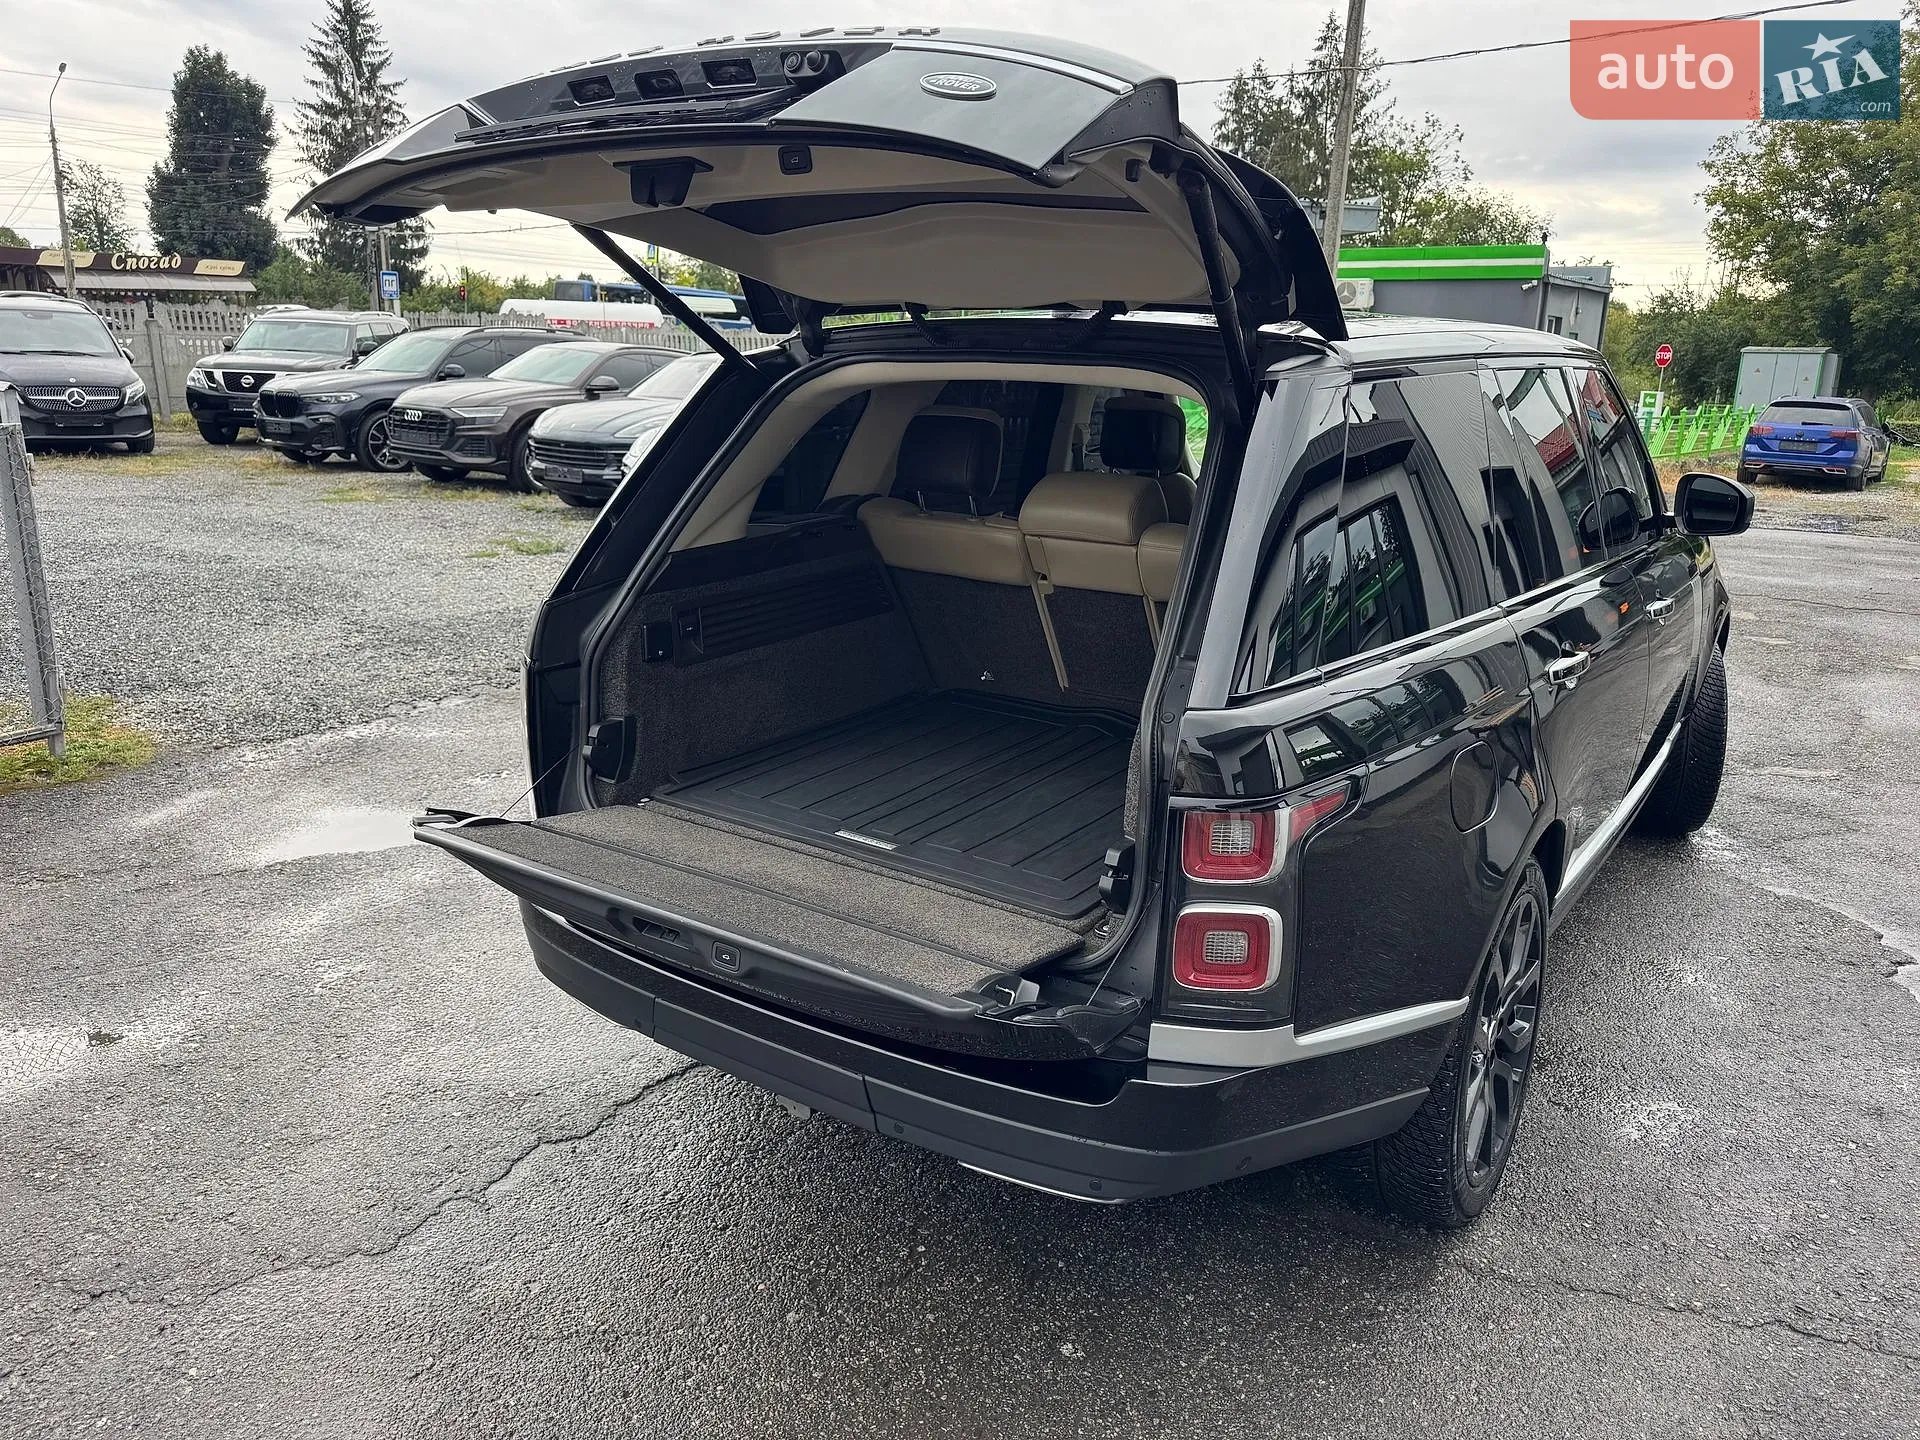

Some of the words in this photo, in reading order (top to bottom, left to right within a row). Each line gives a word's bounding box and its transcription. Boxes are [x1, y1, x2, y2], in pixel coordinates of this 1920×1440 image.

[935, 78, 981, 91] ROVER
[111, 252, 182, 271] Спогад
[1656, 351, 1672, 360] STOP
